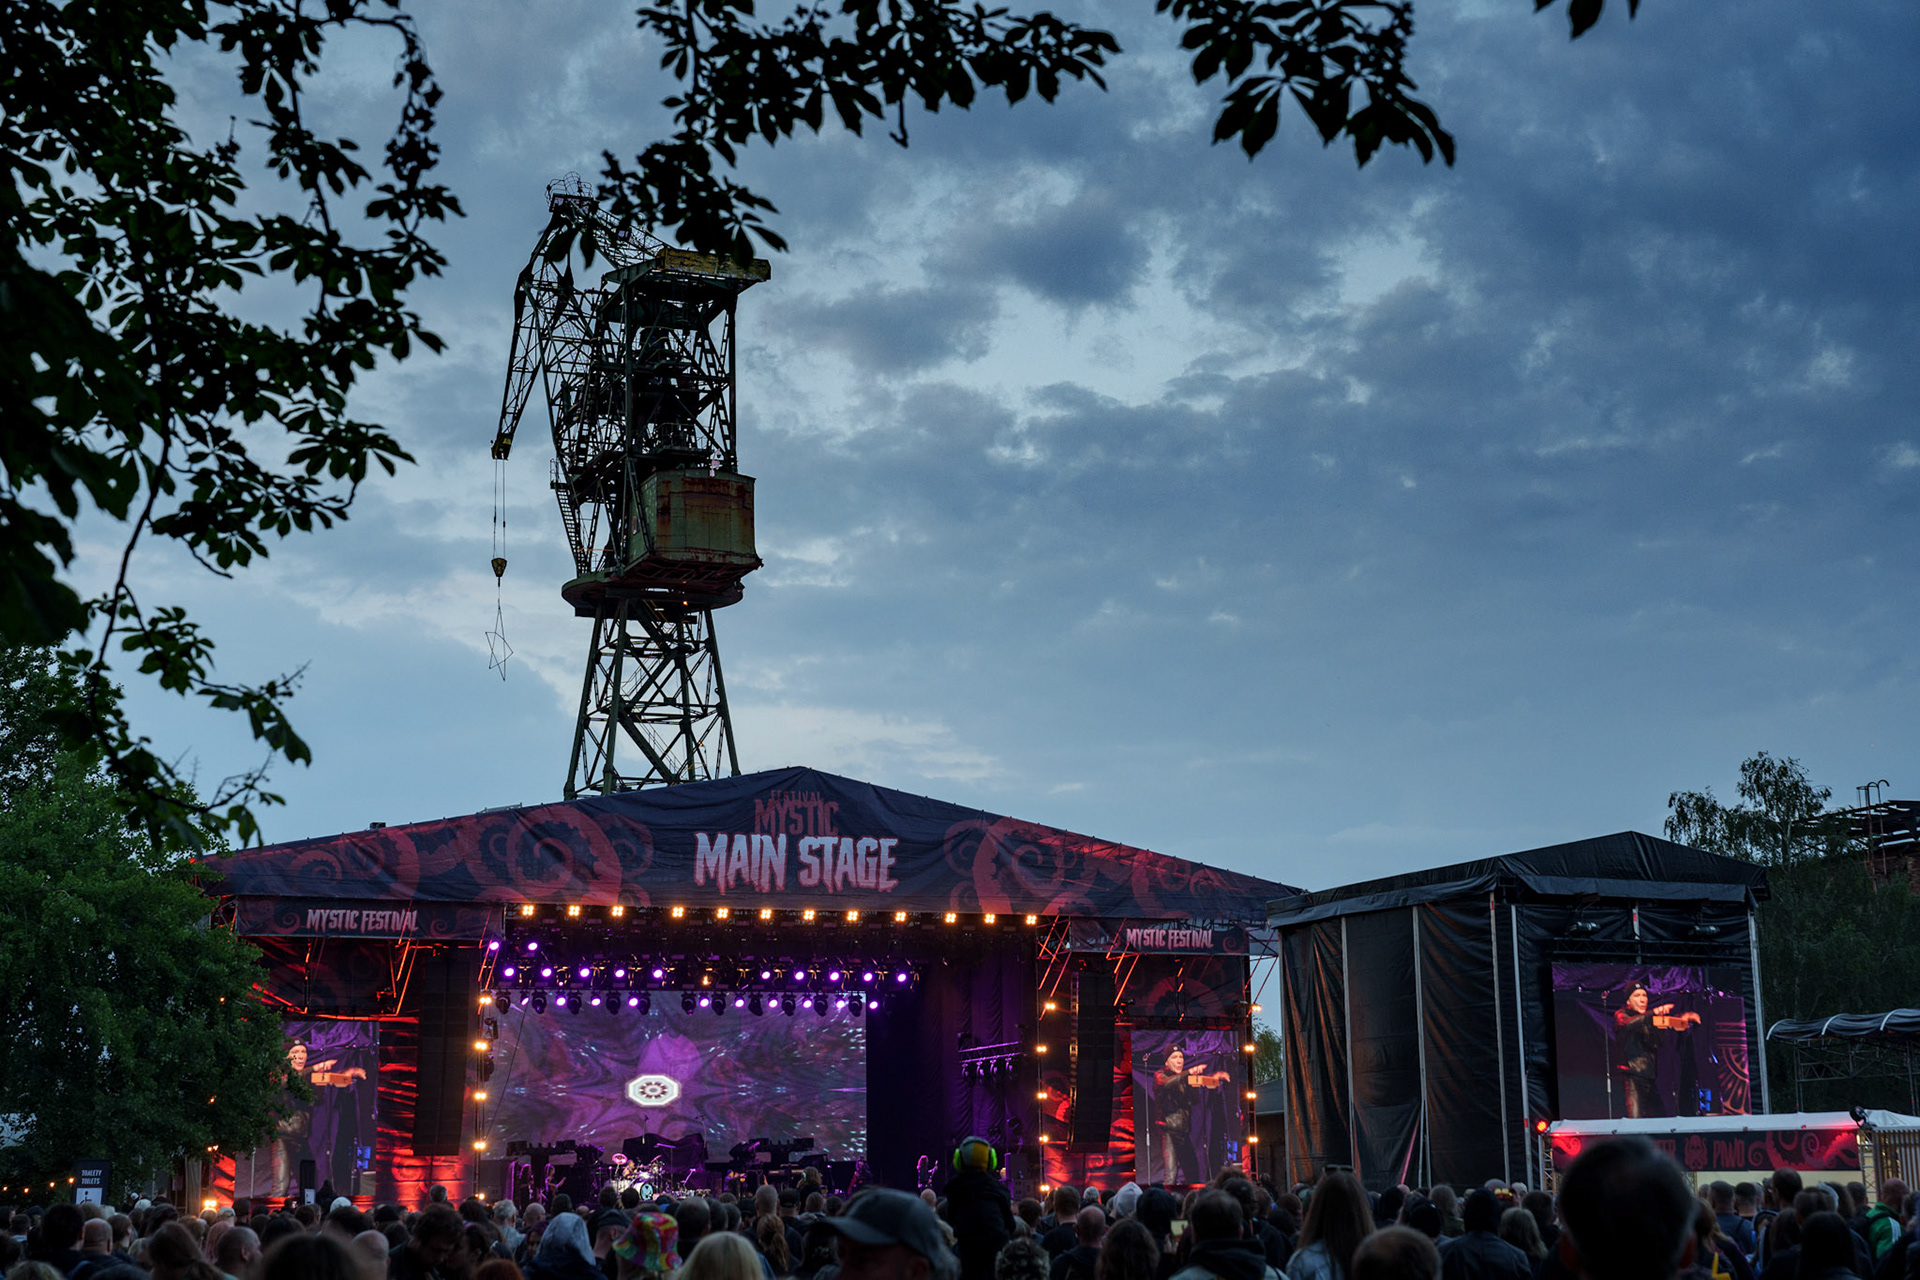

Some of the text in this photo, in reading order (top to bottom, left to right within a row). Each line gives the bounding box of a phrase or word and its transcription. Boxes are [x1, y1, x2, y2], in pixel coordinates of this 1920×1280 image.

[771, 789, 822, 802] FESTIVAL
[754, 798, 840, 837] MYSTIC
[693, 832, 900, 896] MAIN STAGE
[306, 908, 419, 934] MYSTIC FESTIVAL
[1126, 928, 1214, 950] MYSTIC FESTIVAL
[1712, 1138, 1746, 1169] PIWO
